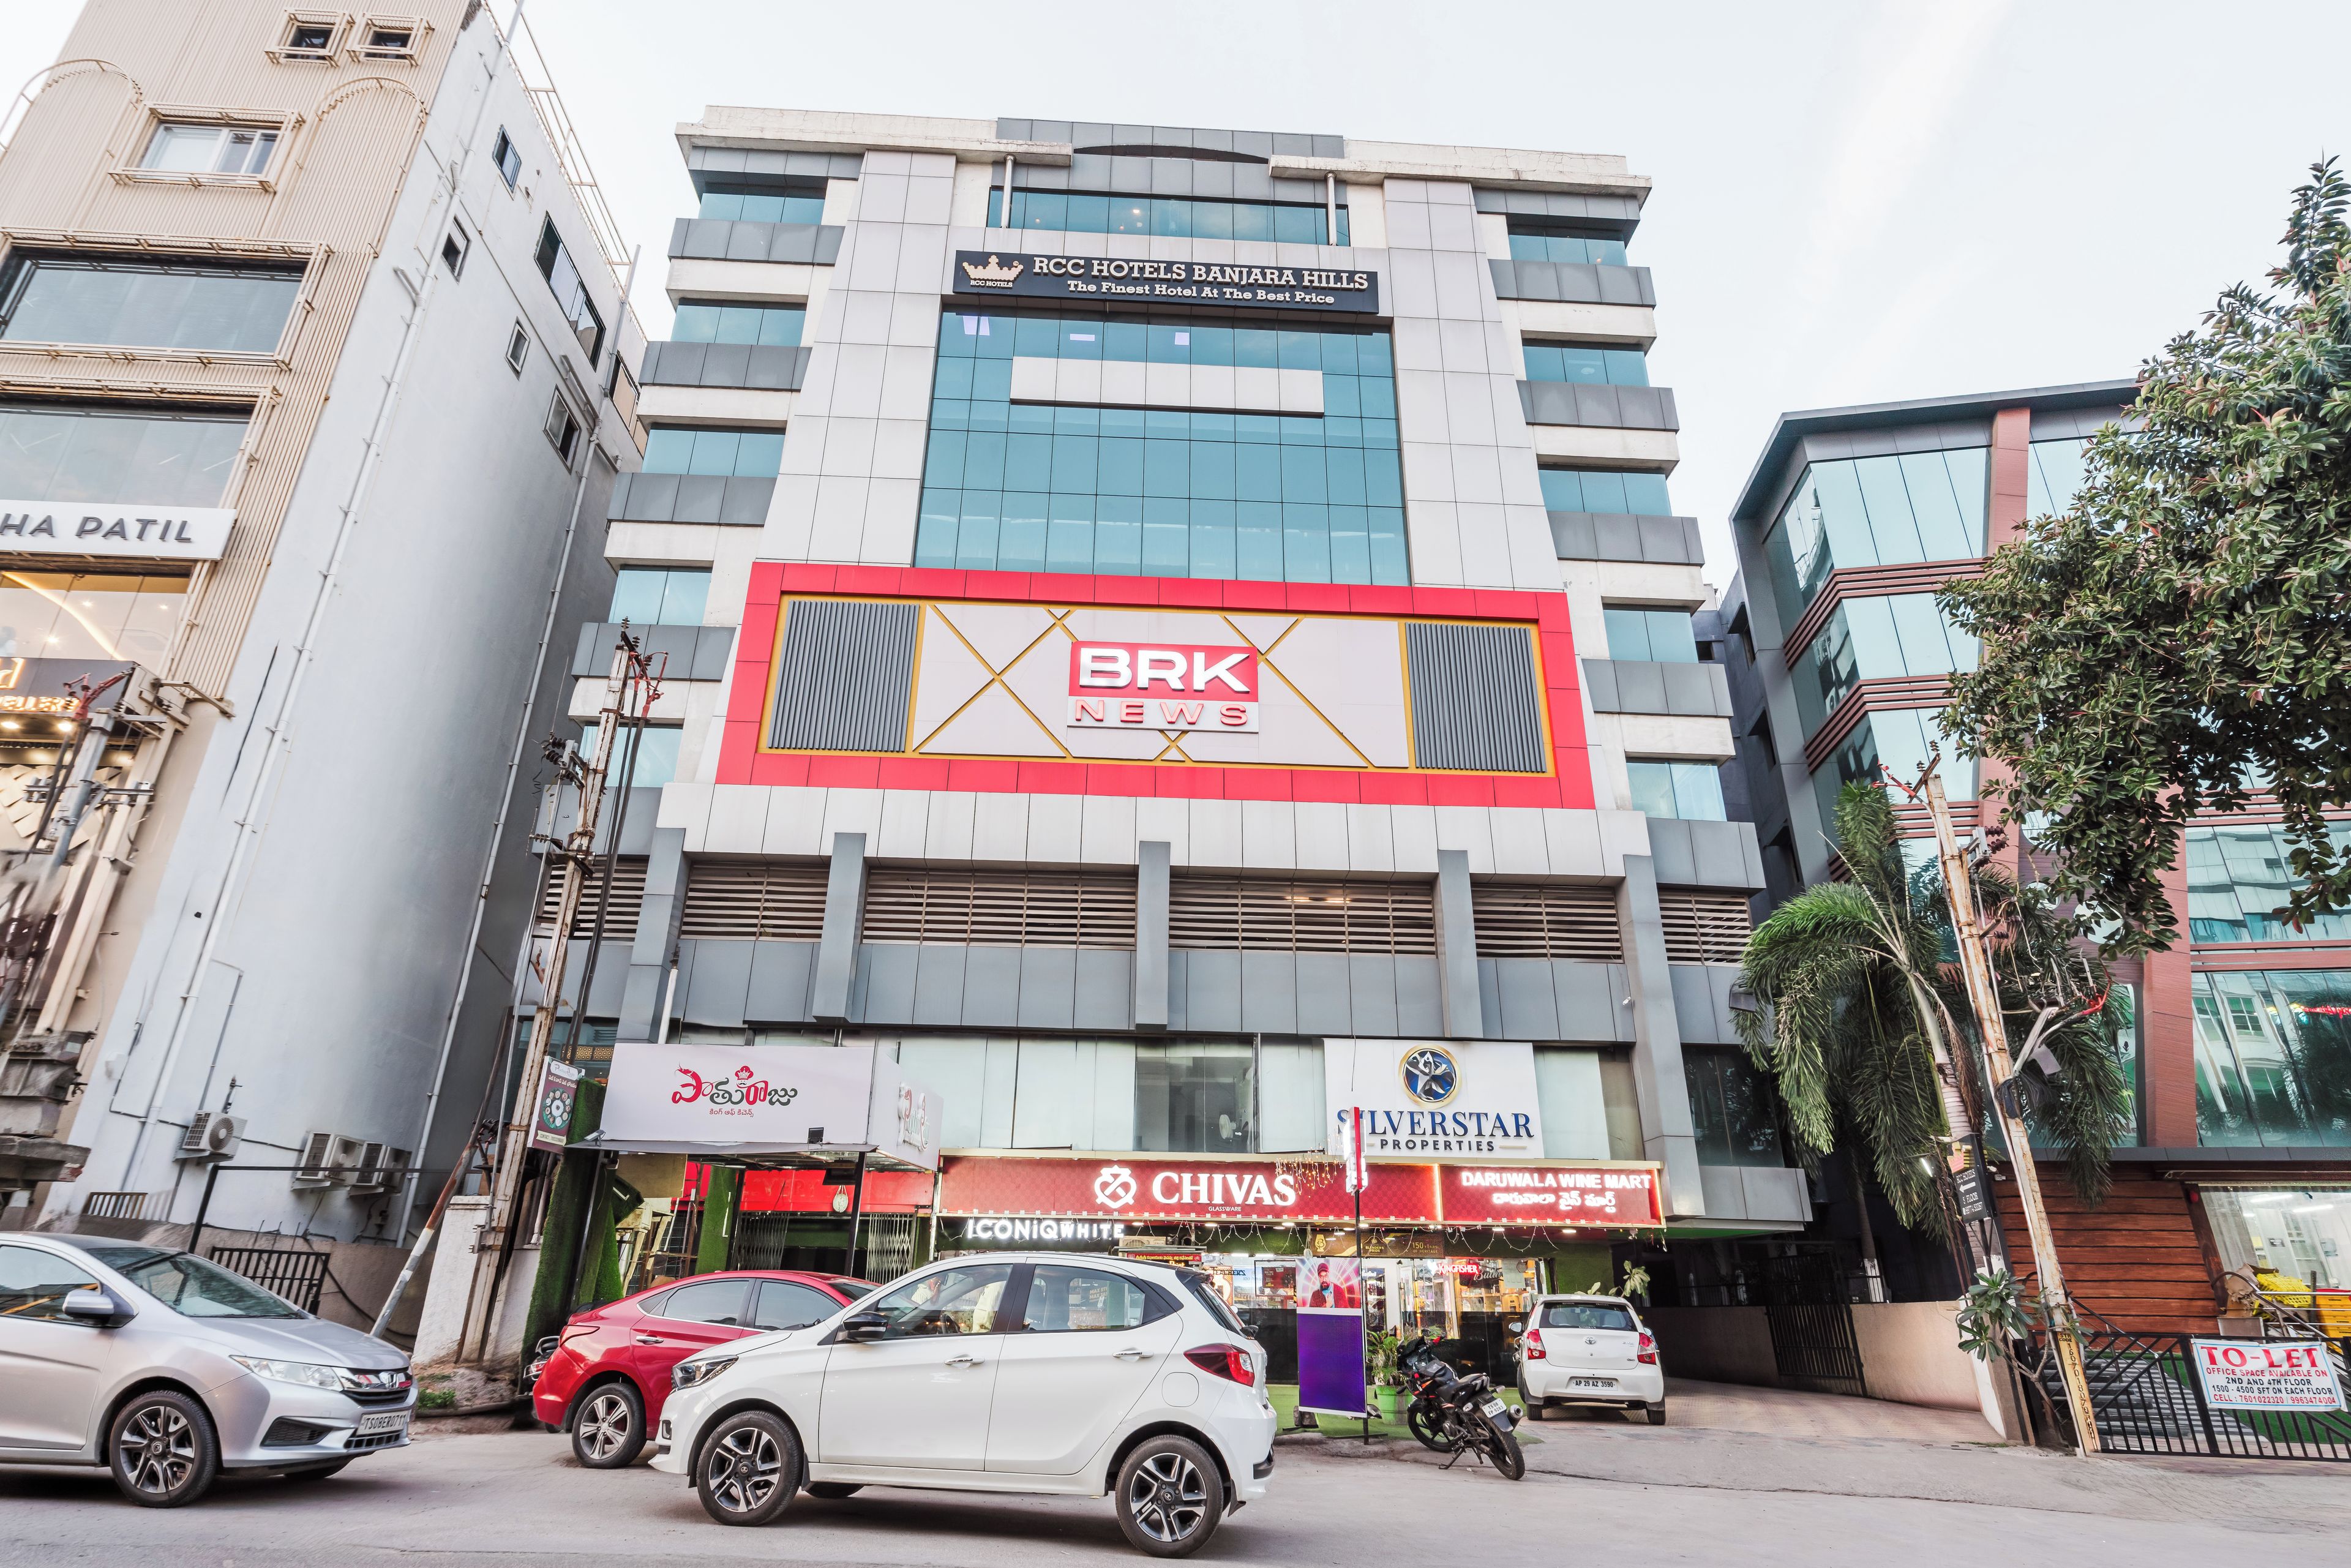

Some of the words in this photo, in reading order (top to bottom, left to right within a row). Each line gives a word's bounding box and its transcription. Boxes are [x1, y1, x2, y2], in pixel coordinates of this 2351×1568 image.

[1033, 257, 1084, 275] RCC
[1091, 259, 1186, 280] HOTELS
[1193, 264, 1297, 285] BANJARA
[1302, 271, 1368, 289] HILLS
[1067, 280, 1097, 292] The
[1101, 282, 1150, 294] Finest
[1155, 284, 1197, 296] Hotel
[1201, 287, 1218, 298] At
[1223, 288, 1252, 299] The
[1256, 289, 1291, 302] Best
[1294, 291, 1335, 304] Price
[0, 513, 55, 536] HA
[75, 516, 192, 542] PATIL
[1079, 647, 1250, 693] BRK
[1075, 699, 1248, 726] NEWS
[1337, 1109, 1535, 1138] SLVERSTAR
[1380, 1139, 1494, 1152] PROPERTIES
[1152, 1171, 1297, 1206] CHIVAS
[1461, 1171, 1557, 1187] DARUWALA
[1558, 1173, 1602, 1188] WINE
[1604, 1174, 1651, 1189] MART
[1966, 1191, 1979, 1203] FLOOR
[1439, 1263, 1479, 1275] KINGFISHER
[2200, 1346, 2319, 1368] TO-LET
[2206, 1367, 2237, 1376] OFFICE
[2239, 1395, 2284, 1404] 7601022320
[2290, 1396, 2336, 1405] 9963474004
